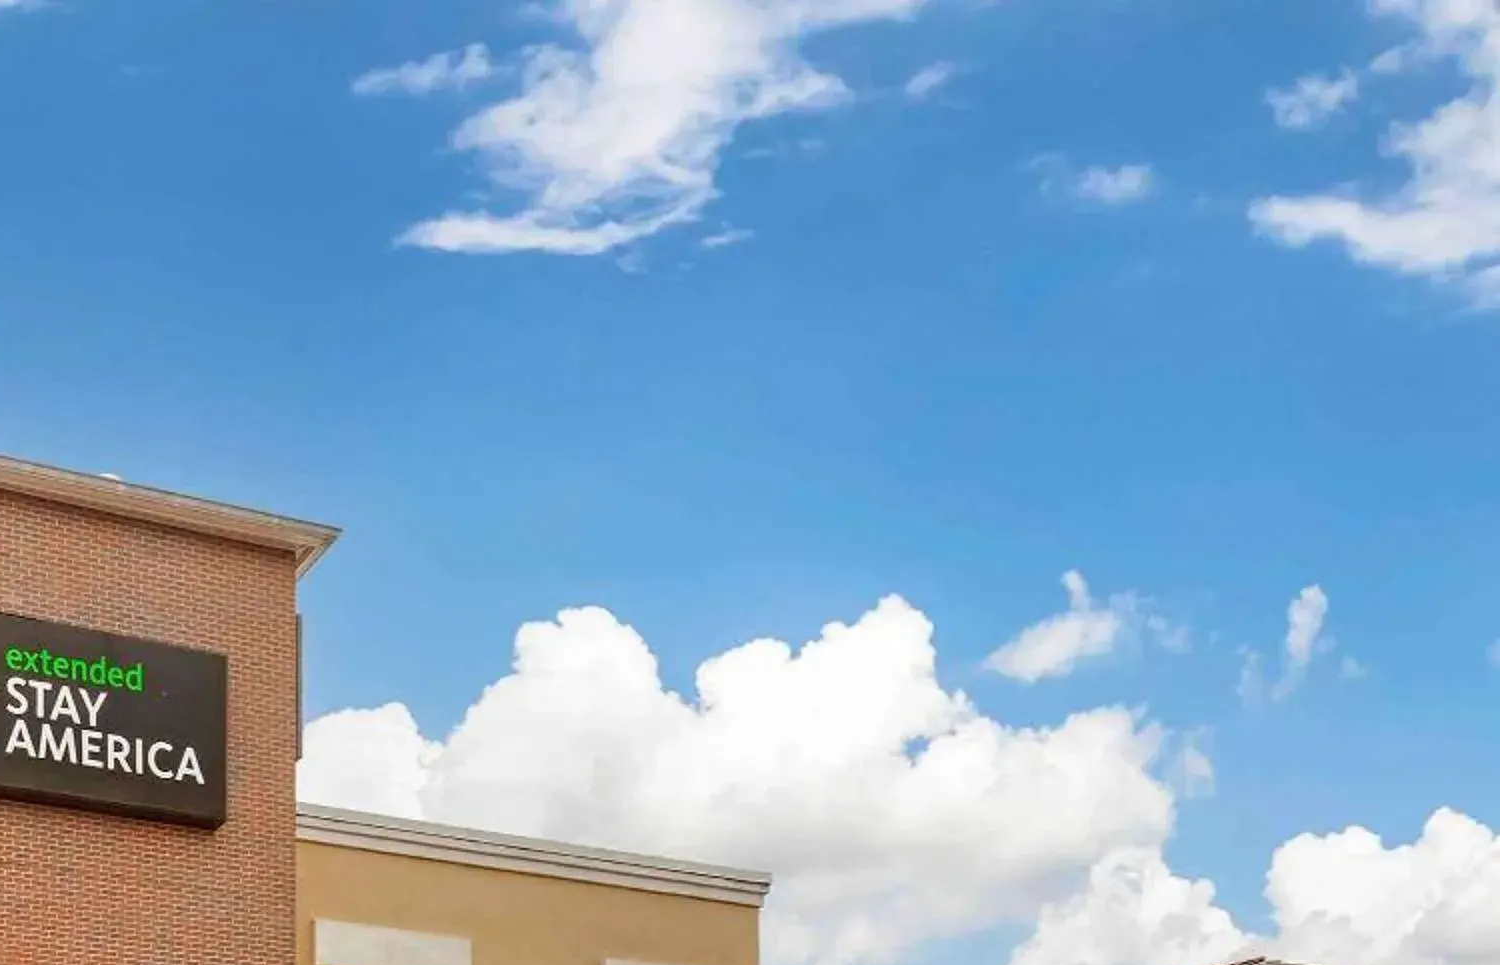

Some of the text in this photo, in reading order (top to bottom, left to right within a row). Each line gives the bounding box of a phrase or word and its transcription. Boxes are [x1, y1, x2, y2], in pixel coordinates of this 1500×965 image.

[5, 645, 145, 692] extended
[5, 676, 107, 727] STAY
[5, 718, 205, 785] AMERICA
